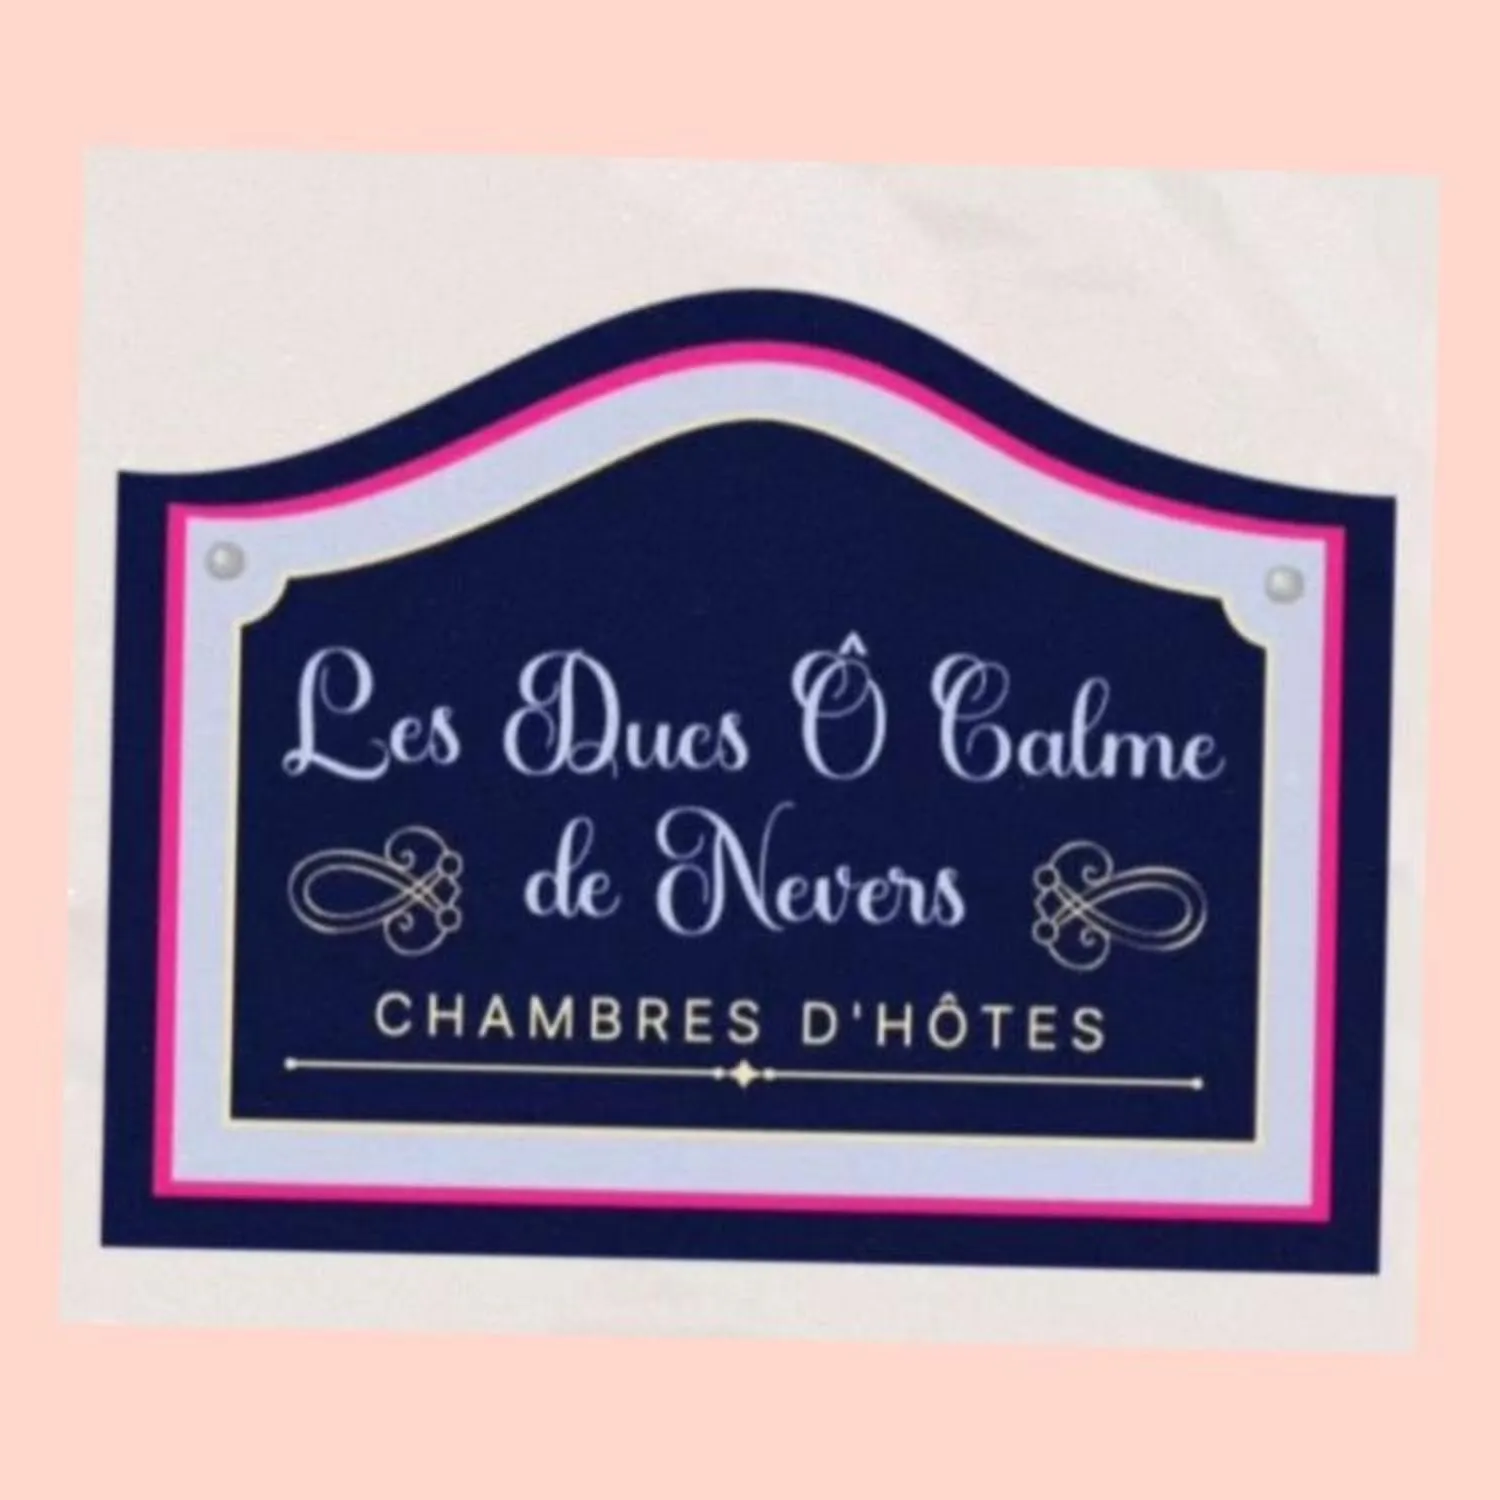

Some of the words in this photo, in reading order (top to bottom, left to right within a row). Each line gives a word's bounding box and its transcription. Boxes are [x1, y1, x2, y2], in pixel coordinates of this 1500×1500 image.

[282, 646, 461, 781] Les
[503, 649, 750, 778] Ducs
[791, 631, 887, 780] Ô
[930, 653, 1225, 782] Calme
[524, 816, 622, 918] de
[655, 802, 966, 935] Nevers
[375, 991, 761, 1045] CHAMBRES
[802, 992, 1105, 1053] D'HÔTES
